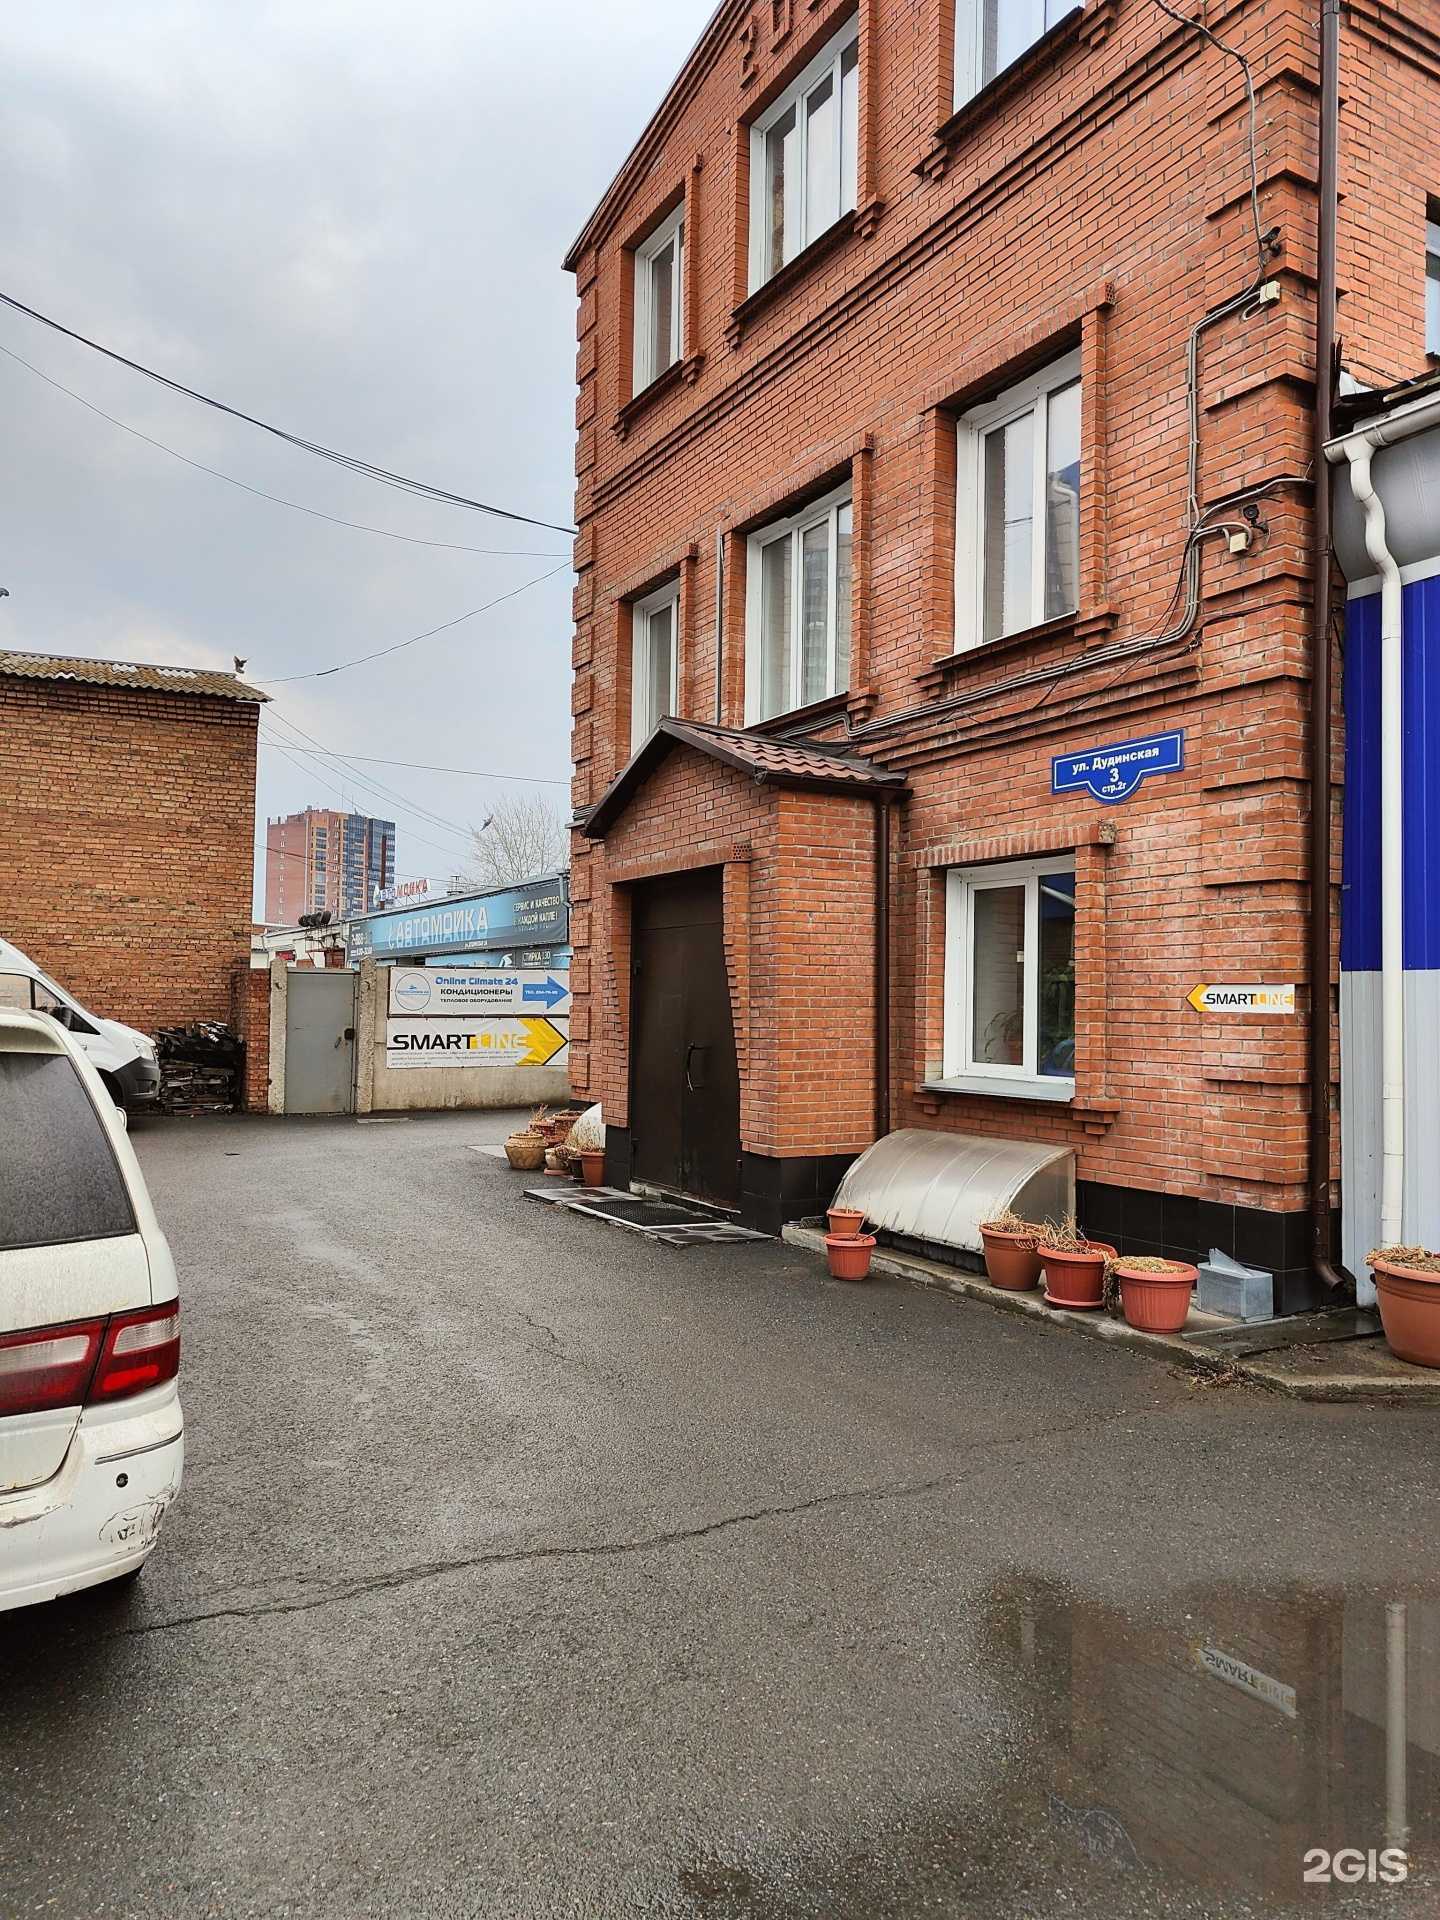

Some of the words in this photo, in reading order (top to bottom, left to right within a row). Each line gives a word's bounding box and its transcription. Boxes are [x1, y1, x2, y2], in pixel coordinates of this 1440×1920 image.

[1072, 762, 1089, 775] ул.
[1092, 747, 1160, 770] Дудинская
[1109, 768, 1119, 782] 3
[1102, 781, 1127, 793] стр.2г
[535, 896, 560, 909] КАЧЕСТВО
[435, 976, 467, 985] Online
[469, 976, 504, 985] Climate
[504, 977, 518, 985] 24
[1203, 993, 1293, 1005] SMARTLINE
[387, 1033, 528, 1050] SMARTLINE
